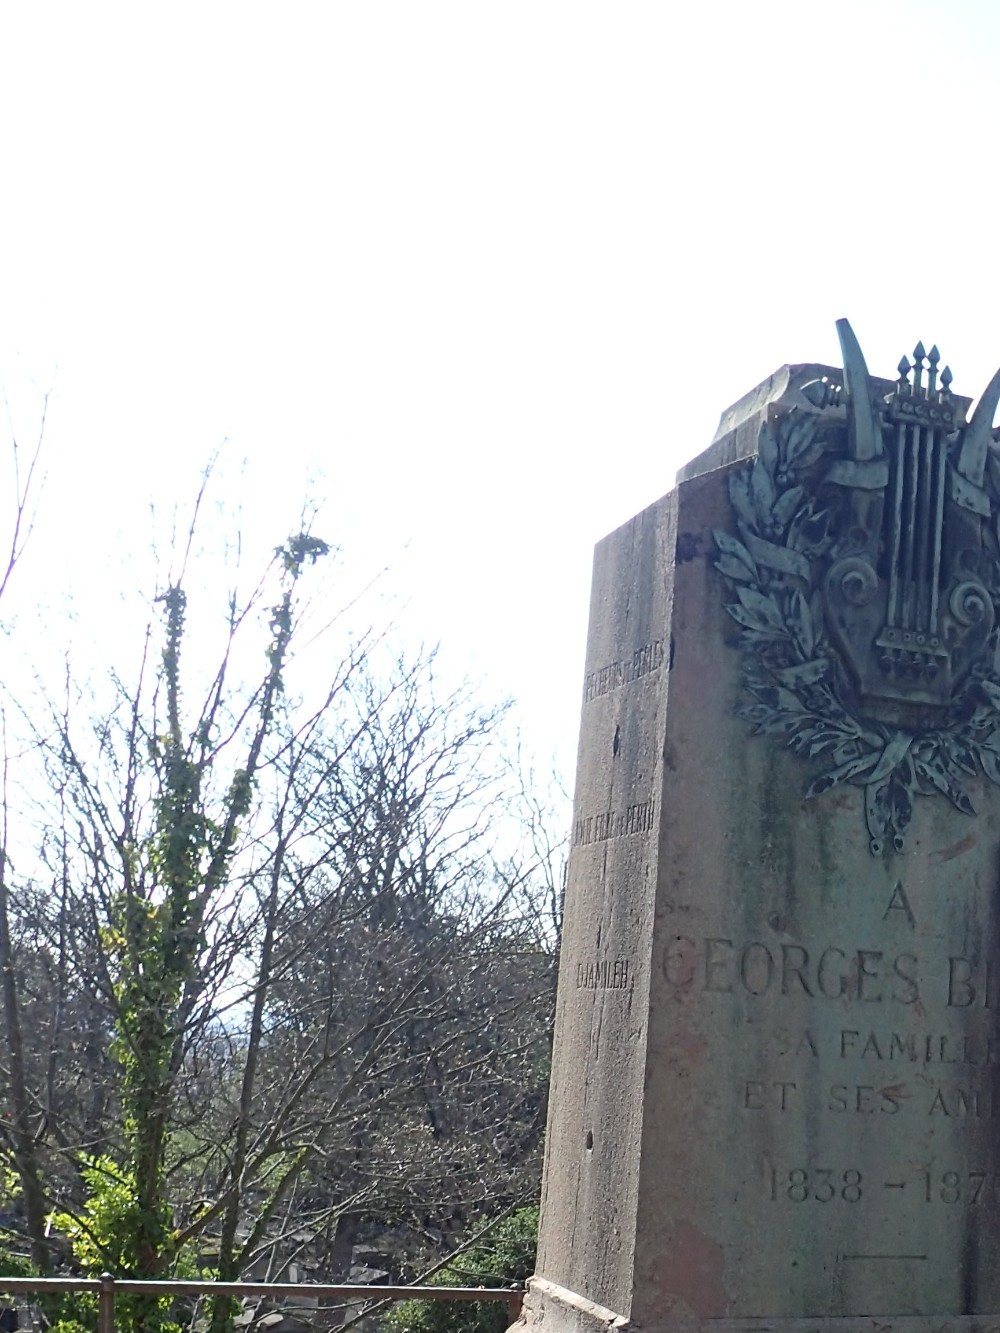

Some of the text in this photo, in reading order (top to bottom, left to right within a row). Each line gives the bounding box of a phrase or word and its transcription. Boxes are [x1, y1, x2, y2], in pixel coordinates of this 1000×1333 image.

[627, 799, 655, 835] PERTH
[882, 879, 916, 929] A
[576, 960, 629, 989] DJAMILEH
[662, 934, 921, 1006] GEORGES
[772, 1026, 819, 1057] SA
[744, 1080, 796, 1112] ET
[828, 1084, 902, 1115] SES
[769, 1168, 863, 1203] 1838
